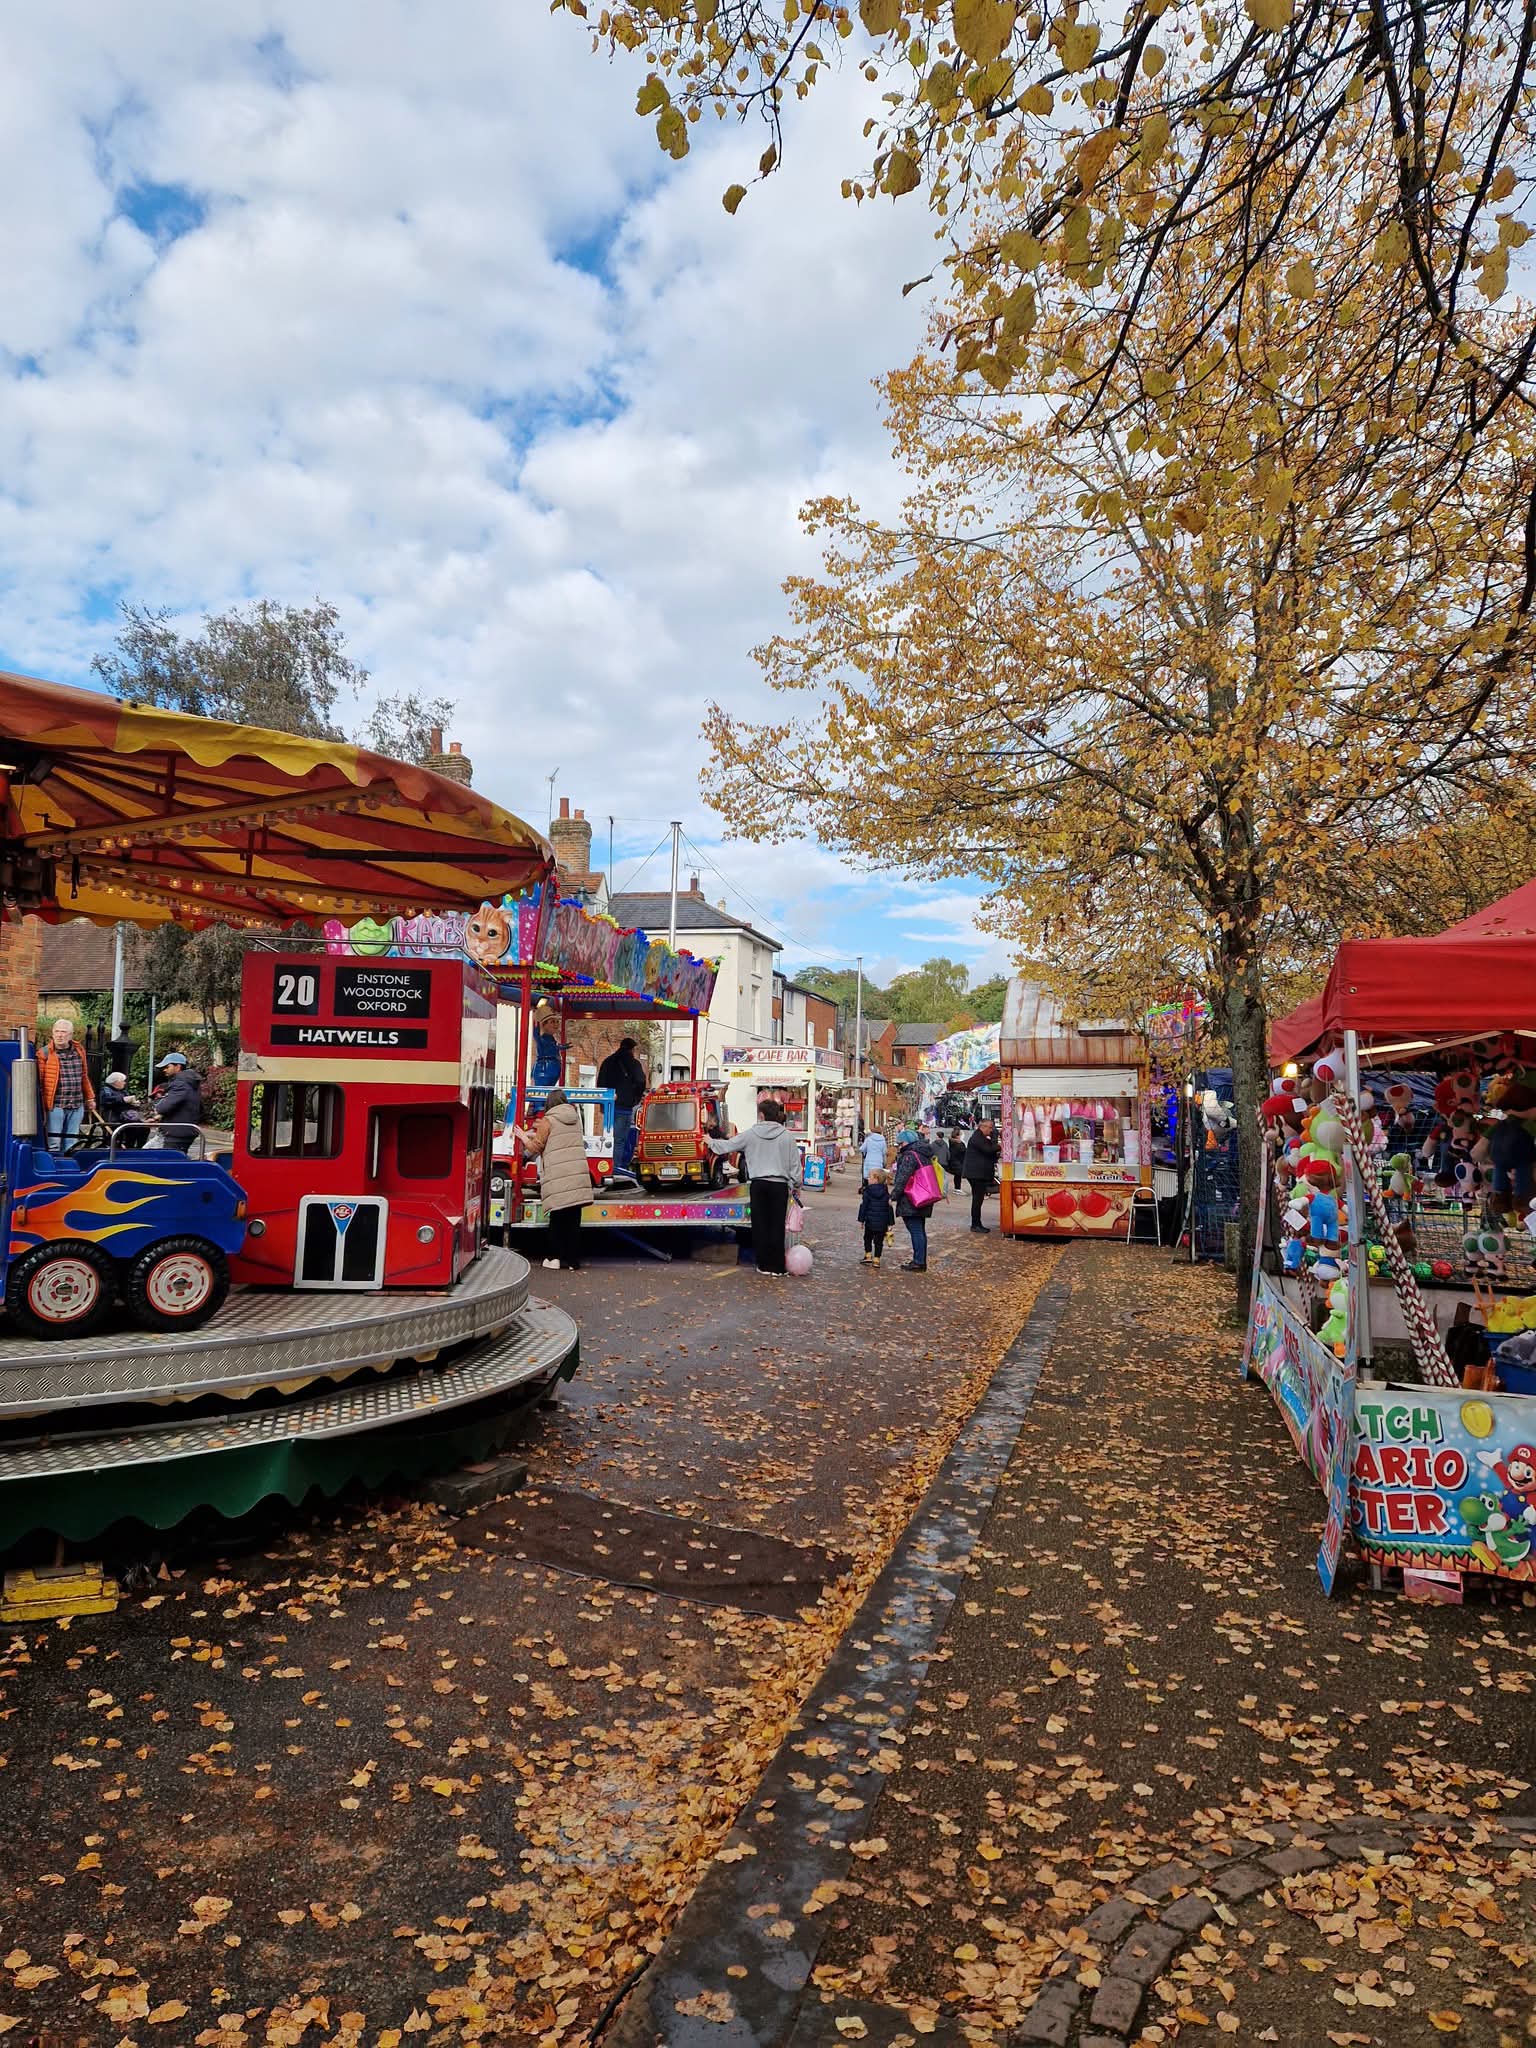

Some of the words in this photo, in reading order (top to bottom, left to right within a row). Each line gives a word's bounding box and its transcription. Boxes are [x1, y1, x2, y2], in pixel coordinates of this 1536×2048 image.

[357, 974, 410, 985] ENSTONE
[278, 974, 316, 1007] 20
[343, 986, 423, 999] WOODSTOCK
[357, 1001, 407, 1012] OXFORD
[298, 1029, 400, 1045] HATWELLS
[757, 1049, 785, 1062] CAFE
[787, 1050, 809, 1063] BAR
[1350, 1443, 1469, 1491] ARIO
